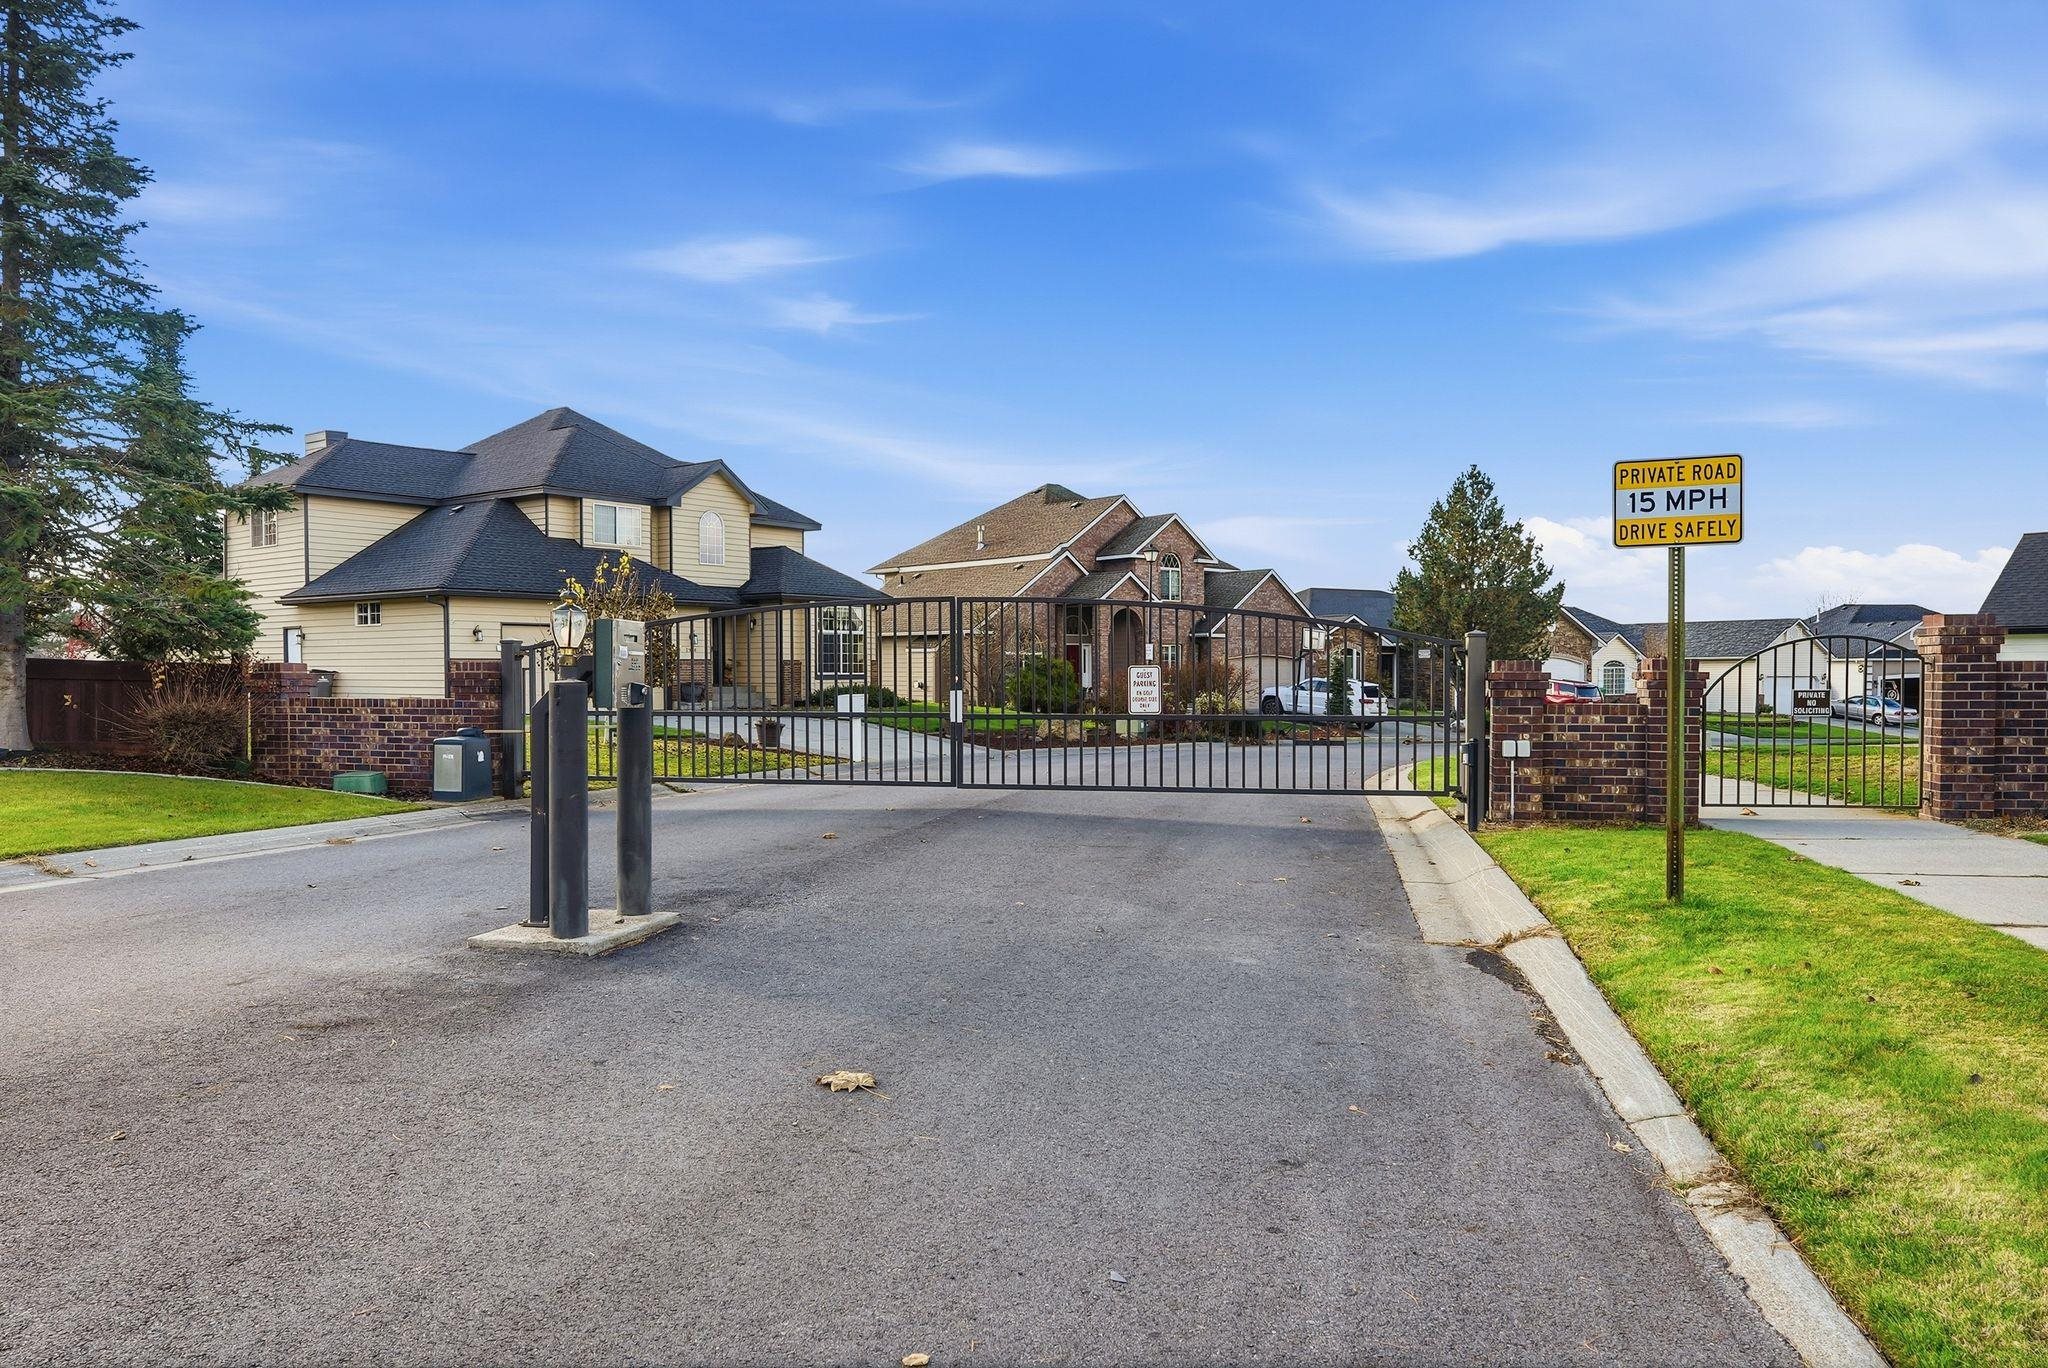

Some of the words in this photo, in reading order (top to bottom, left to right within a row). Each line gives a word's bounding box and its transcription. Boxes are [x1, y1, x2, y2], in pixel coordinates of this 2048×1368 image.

[1620, 466, 1685, 485] PRIVATE
[1693, 463, 1736, 480] ROAD
[1629, 491, 1656, 513] 15
[1666, 487, 1727, 511] MPH
[1620, 523, 1667, 540] DRIVE
[1674, 519, 1736, 538] SAFELY
